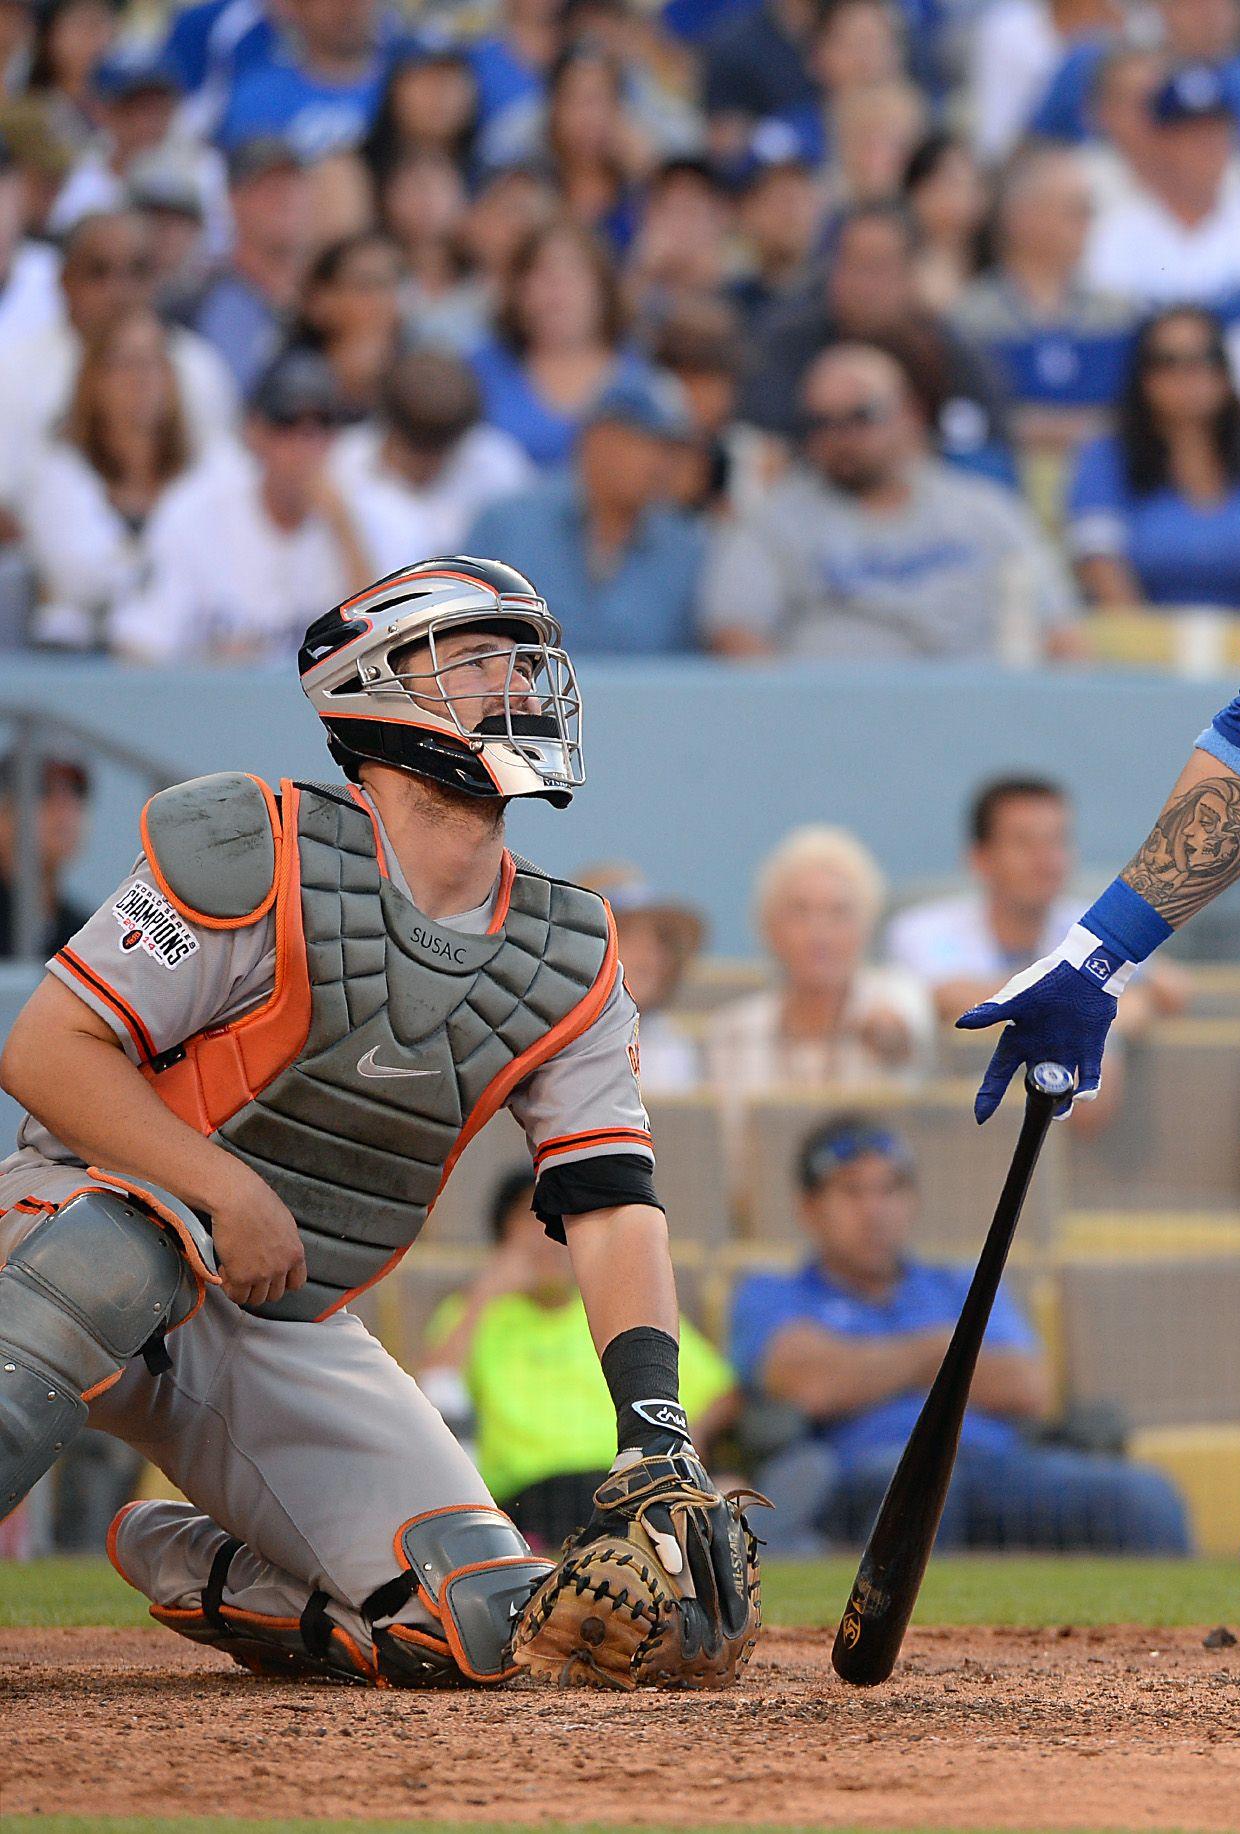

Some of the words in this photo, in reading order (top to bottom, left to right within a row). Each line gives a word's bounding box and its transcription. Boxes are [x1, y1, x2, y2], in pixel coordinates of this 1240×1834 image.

[115, 889, 190, 966] CHAMPIONS
[135, 883, 163, 907] WORLD
[164, 907, 197, 950] SERIES
[410, 927, 467, 965] SUSAC
